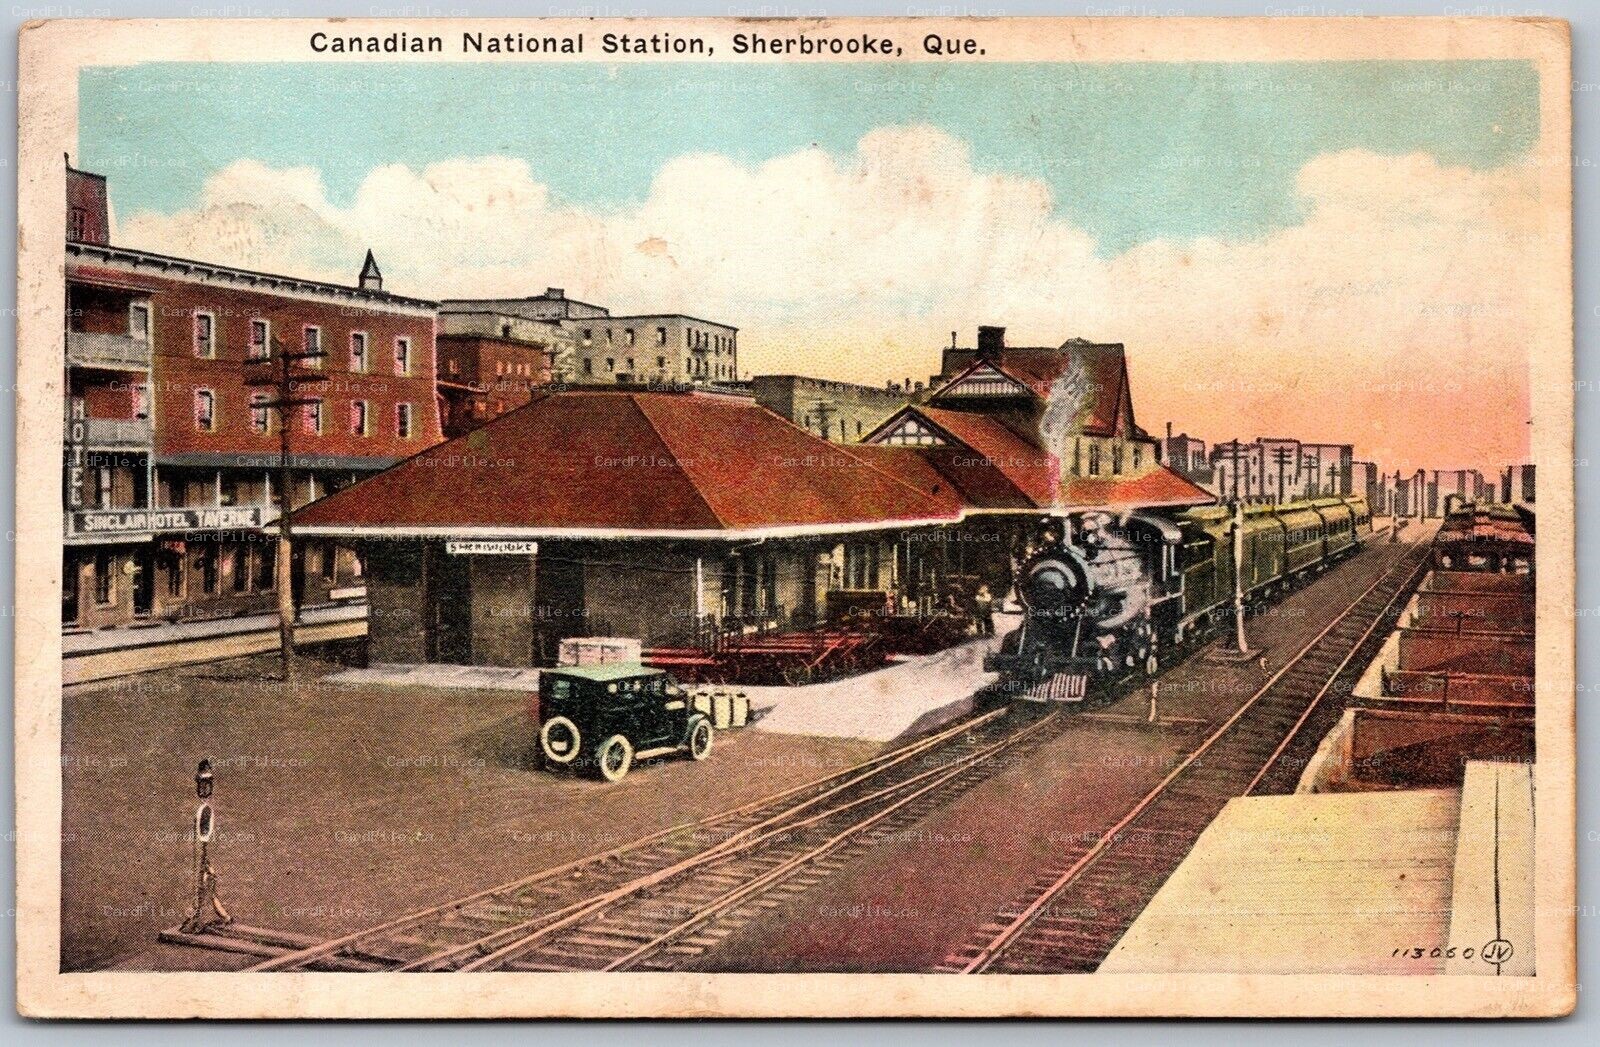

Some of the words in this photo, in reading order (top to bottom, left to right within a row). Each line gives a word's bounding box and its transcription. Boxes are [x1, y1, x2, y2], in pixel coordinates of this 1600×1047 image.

[310, 32, 442, 53] Canadian
[463, 32, 583, 54] National
[602, 32, 714, 57] Station,
[732, 33, 903, 57] Sherbrooke,
[923, 33, 986, 56] Que.
[72, 398, 85, 506] HOTEL
[84, 513, 147, 532] SINCLAIR
[195, 508, 256, 529] TAVERNE
